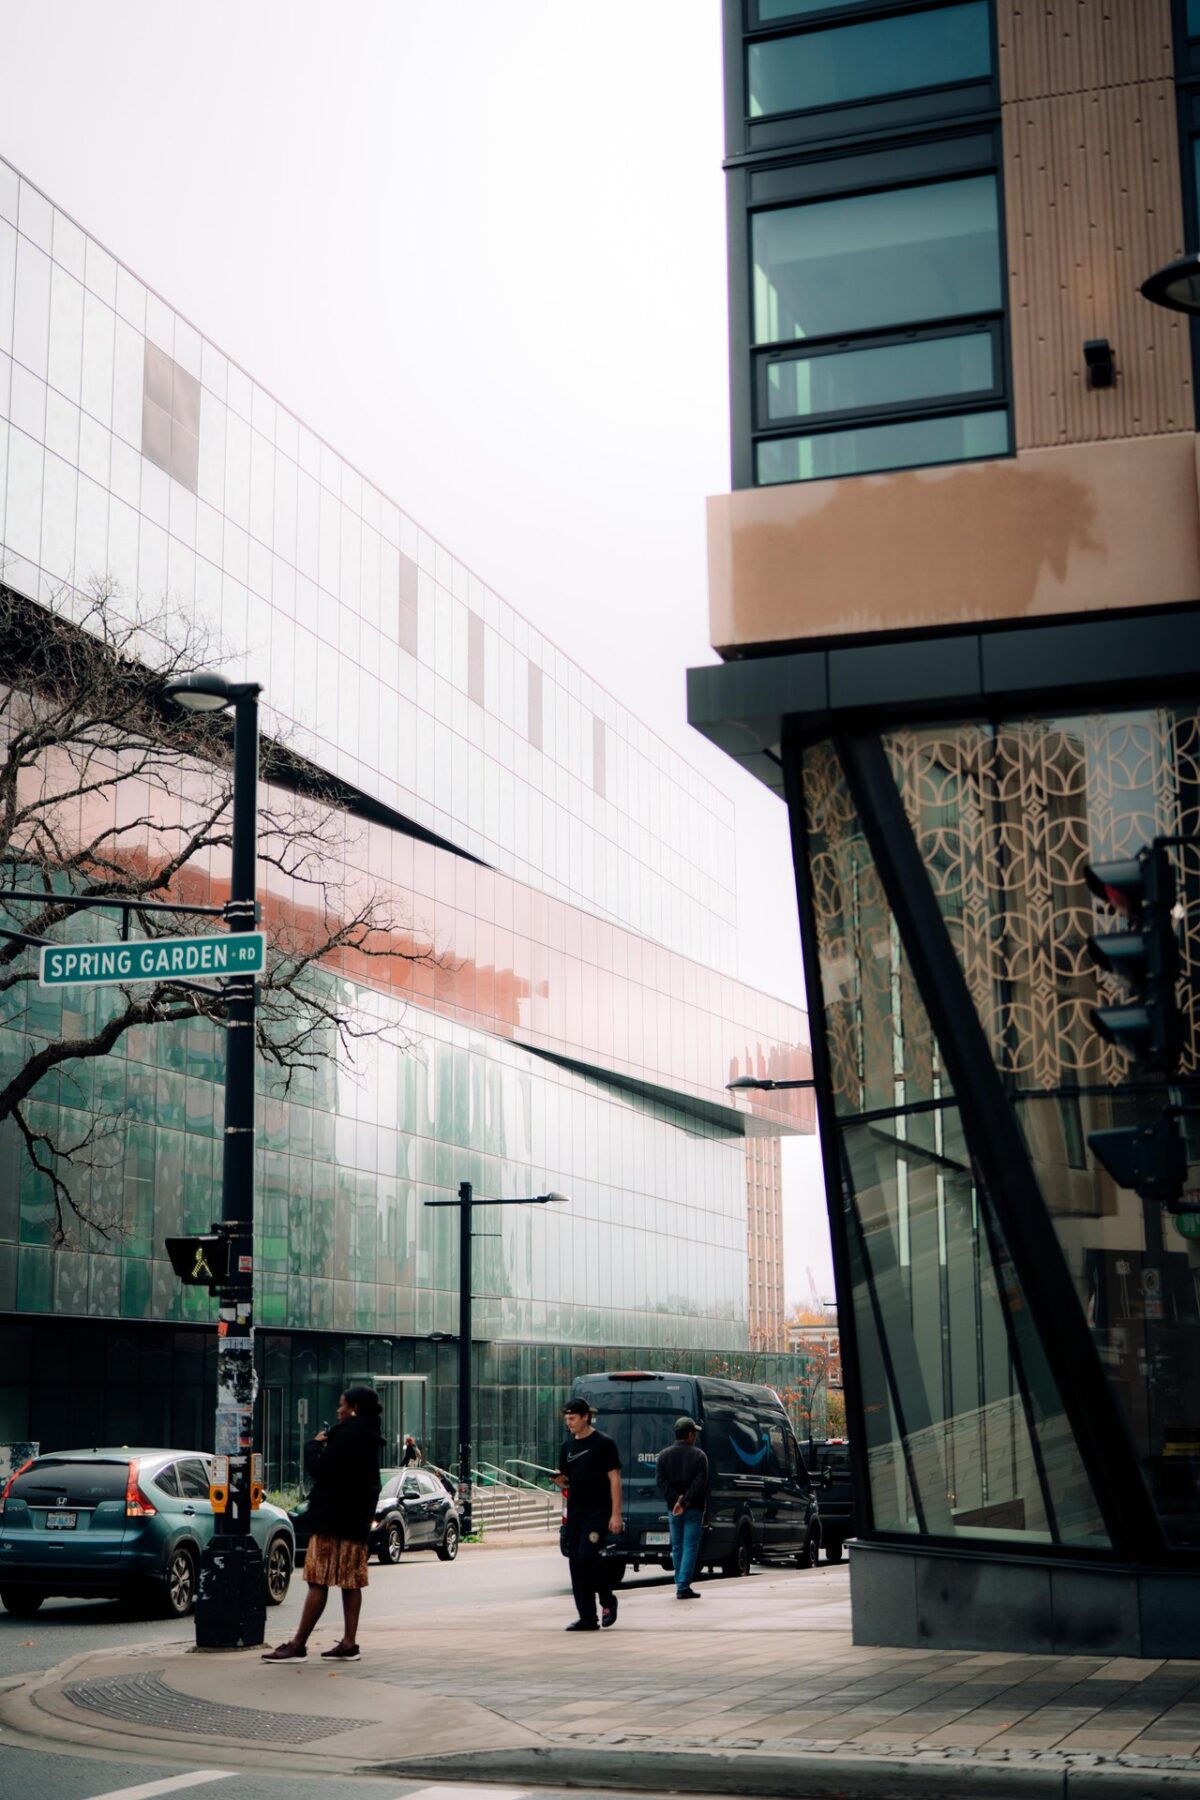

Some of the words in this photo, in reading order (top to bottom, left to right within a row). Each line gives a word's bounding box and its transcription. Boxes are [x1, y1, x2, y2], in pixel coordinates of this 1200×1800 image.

[51, 951, 132, 978] SPRING
[141, 943, 228, 972] GARDEN
[238, 946, 256, 961] RD
